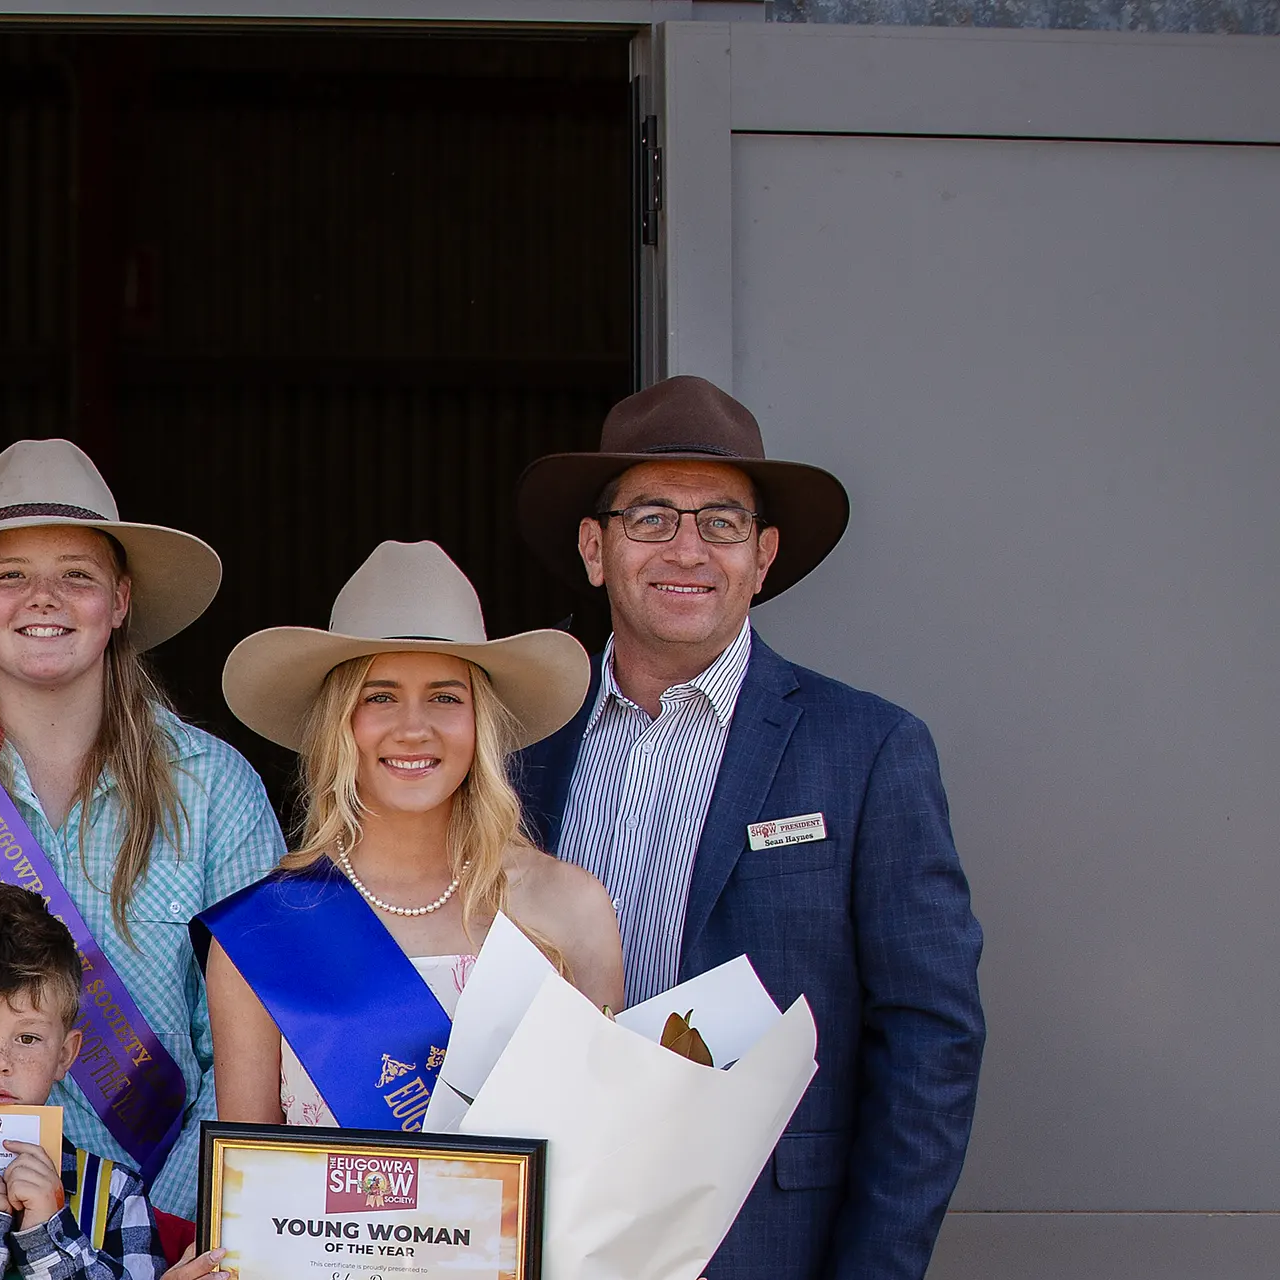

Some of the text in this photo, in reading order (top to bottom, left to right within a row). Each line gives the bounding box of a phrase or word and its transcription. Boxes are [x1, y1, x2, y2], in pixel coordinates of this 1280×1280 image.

[780, 820, 820, 832] PRESIDENT
[764, 838, 784, 847] Sean
[785, 833, 814, 843] Haynes
[86, 978, 152, 1068] SOCIETY
[80, 1034, 110, 1065] OF
[90, 1056, 132, 1101] THE
[337, 1158, 414, 1173] EUGOWRA
[329, 1170, 414, 1196] SHOW
[384, 1196, 412, 1204] SOCIETY
[272, 1217, 471, 1246] YOUNG WOMAN
[324, 1242, 415, 1257] OF THE YEAR
[363, 1264, 386, 1272] proudly
